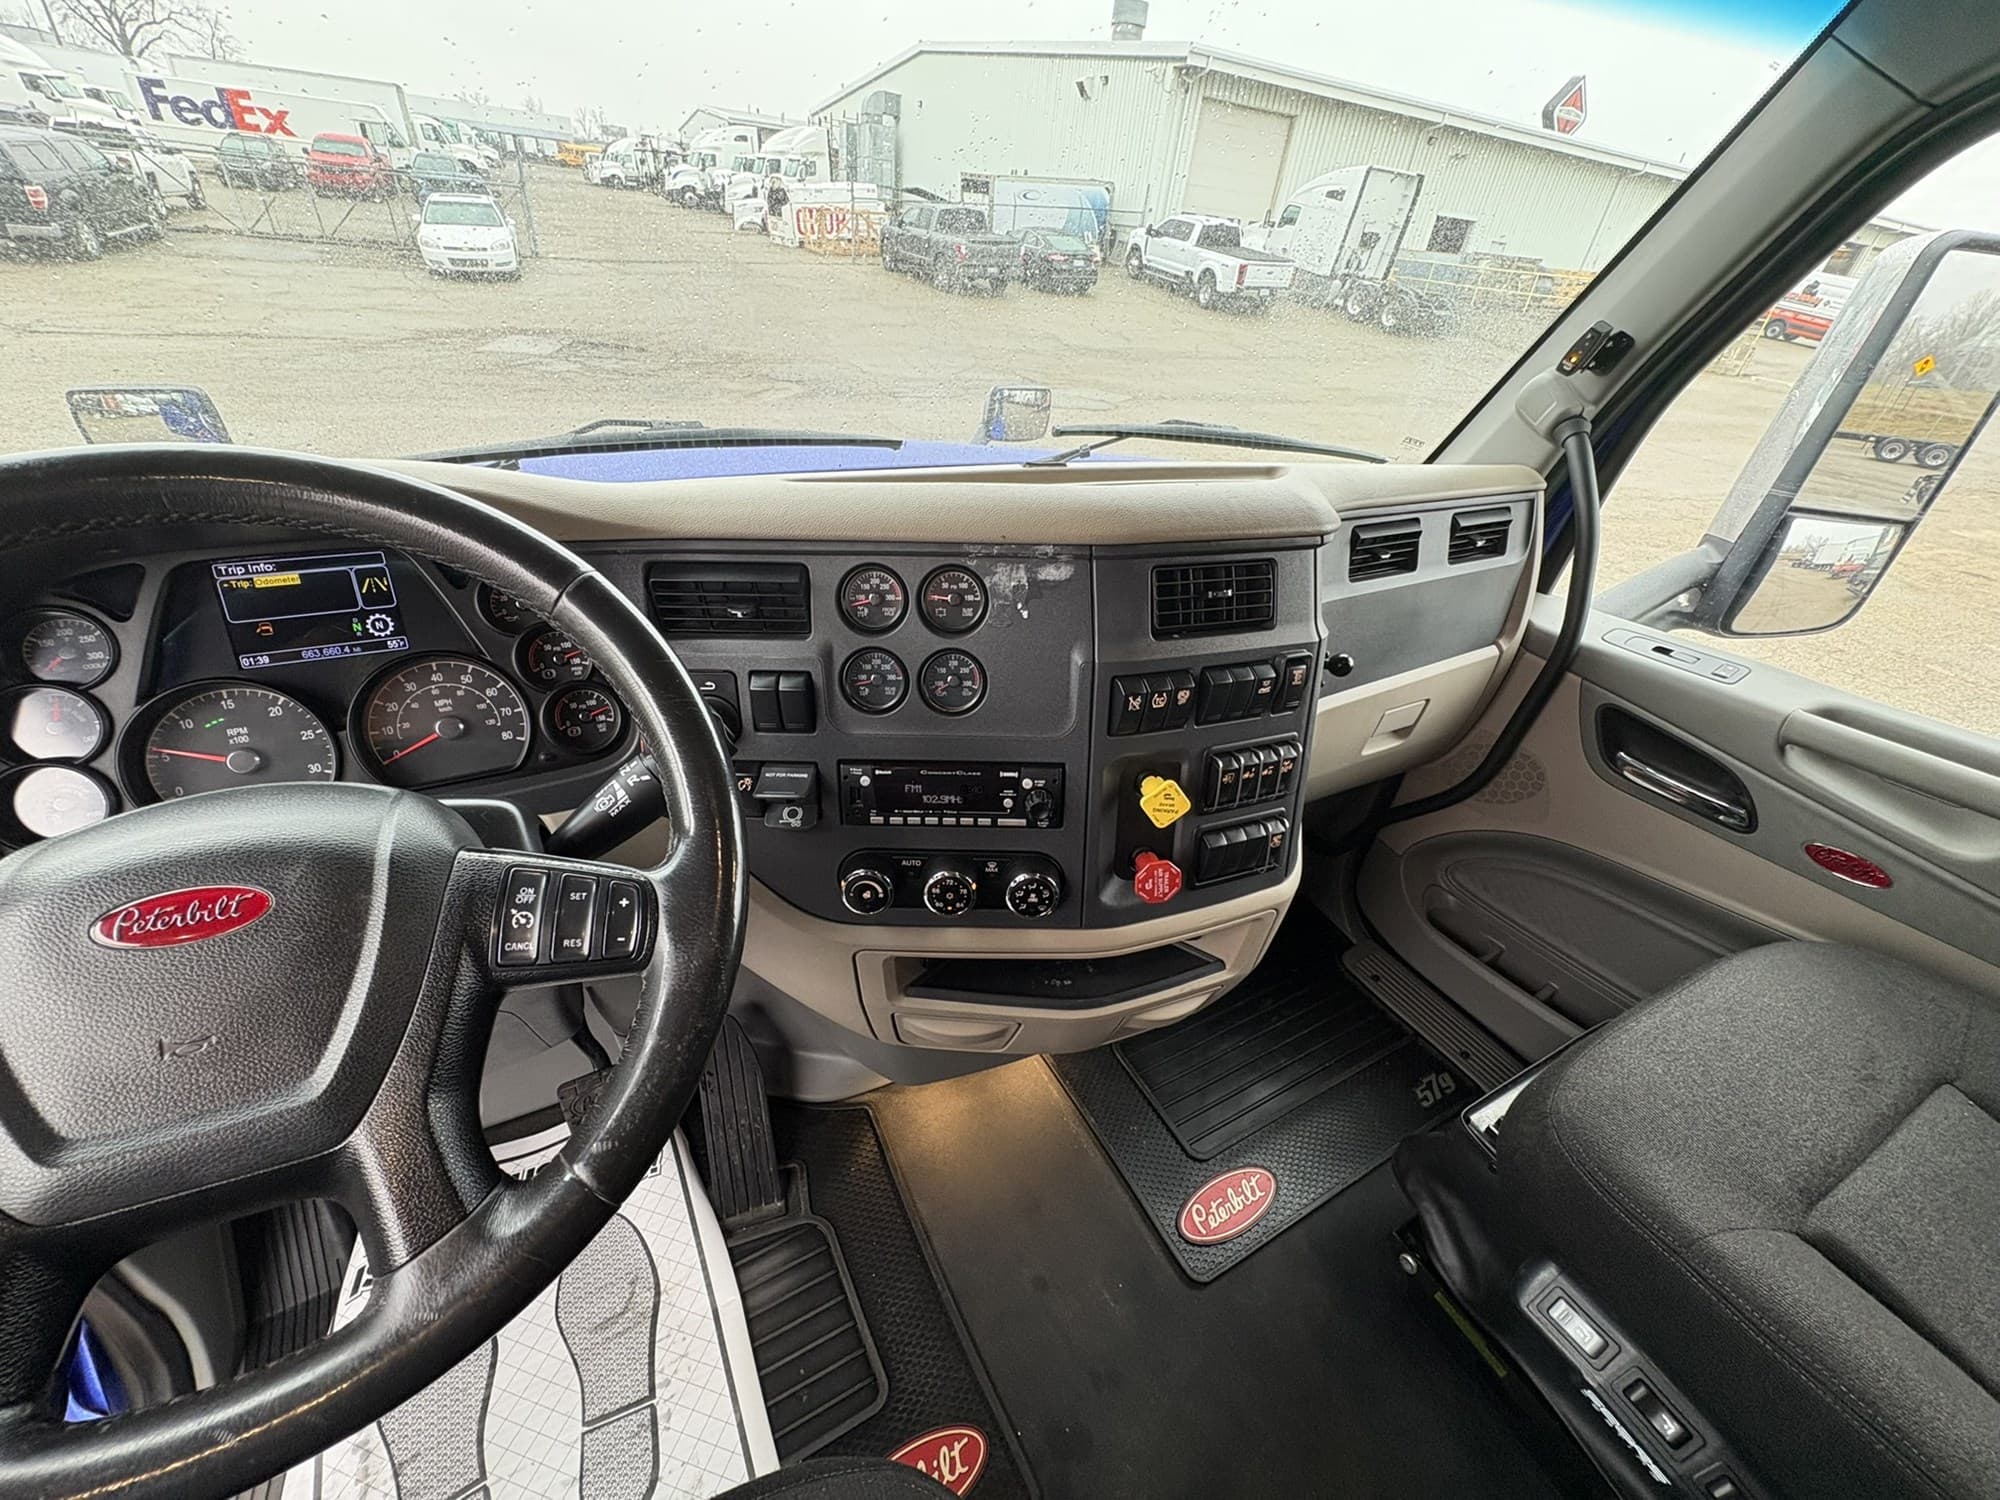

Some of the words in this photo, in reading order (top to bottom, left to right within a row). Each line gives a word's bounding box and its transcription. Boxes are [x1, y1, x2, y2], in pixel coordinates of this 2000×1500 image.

[136, 76, 298, 137] FedEx
[218, 564, 245, 576] Trip
[248, 562, 277, 574] Info:
[231, 579, 253, 589] Trip:
[254, 575, 300, 588] Odometer
[352, 622, 362, 632] N
[375, 619, 384, 631] N
[55, 627, 73, 637] 200
[78, 634, 96, 643] 250
[86, 651, 104, 659] 300
[242, 654, 271, 667] 01:39
[861, 663, 872, 671] 150
[880, 663, 891, 671] 250
[430, 672, 443, 683] 40
[460, 673, 472, 685] 50
[856, 673, 867, 681] 100
[403, 681, 416, 693] 30
[431, 688, 439, 696] 60
[485, 686, 497, 698] 60
[221, 699, 234, 710] 15
[385, 701, 398, 712] 20
[433, 699, 454, 708] MPH
[475, 702, 487, 711] 100
[268, 705, 282, 718] 20
[500, 707, 512, 717] 70
[180, 718, 193, 730] 10
[402, 721, 410, 730] 20
[226, 726, 249, 737] RPM
[300, 729, 314, 741] 25
[381, 725, 394, 736] 10
[501, 730, 513, 741] 80
[229, 734, 250, 745] x100
[161, 753, 169, 763] 5
[307, 763, 321, 774] 30
[626, 774, 640, 787] R
[175, 785, 183, 797] 0
[901, 859, 922, 867] AUTO
[519, 887, 534, 895] ON
[569, 891, 589, 901] SET
[515, 896, 536, 905] OFF
[113, 892, 256, 942] Peterbilt
[504, 941, 536, 951] CANCL
[562, 938, 583, 948] RES
[1416, 1072, 1456, 1107] 579
[1191, 1173, 1266, 1236] Peterbilt
